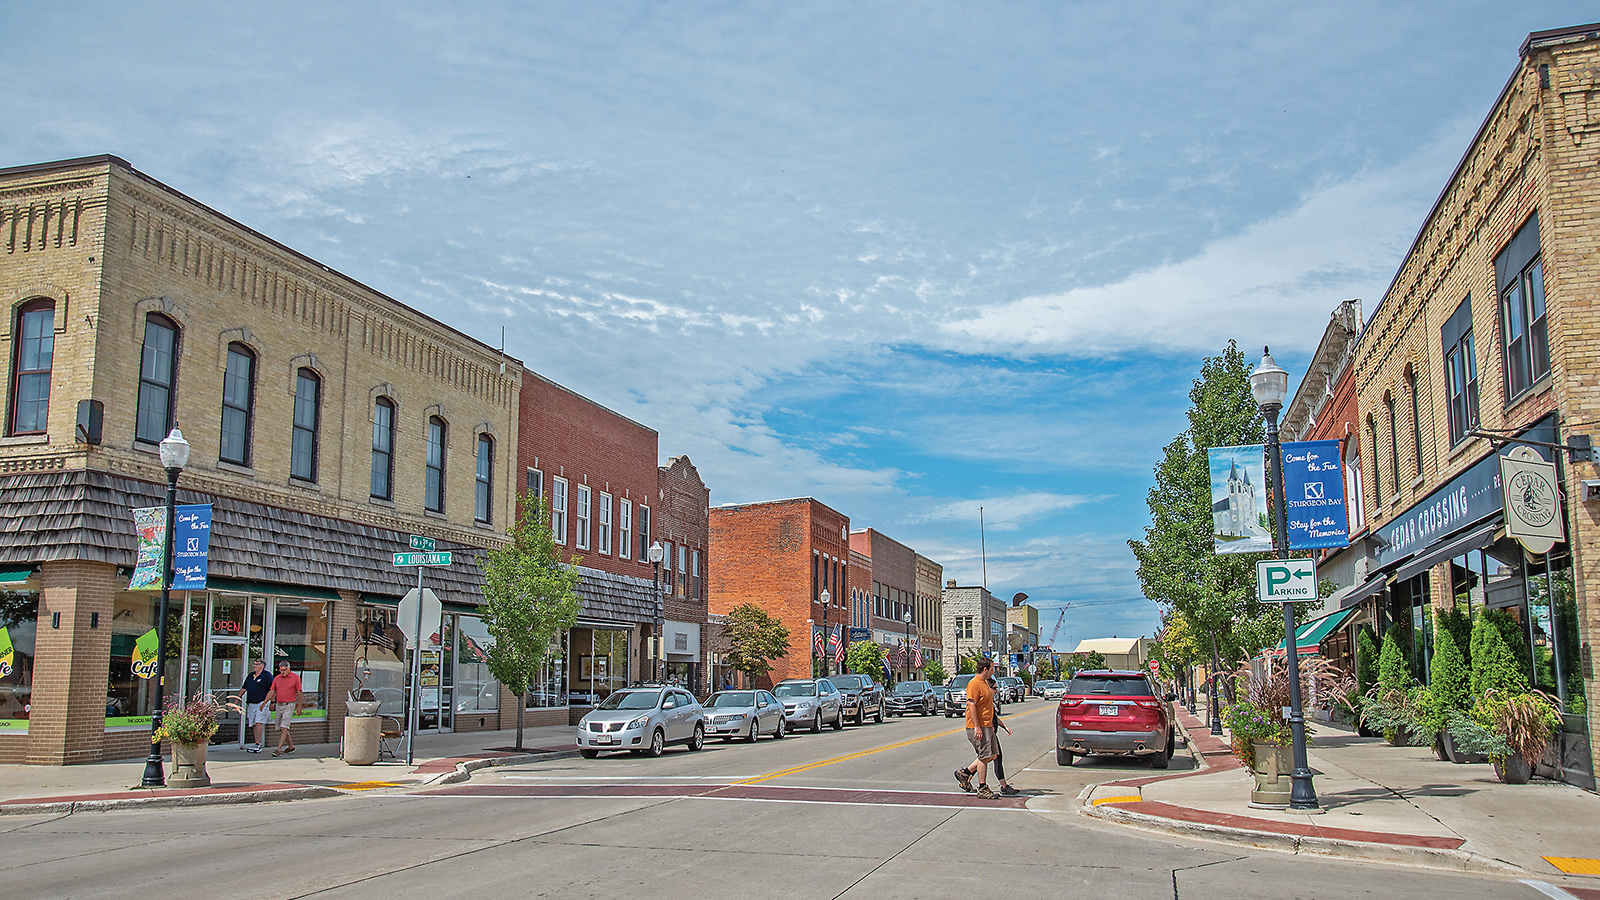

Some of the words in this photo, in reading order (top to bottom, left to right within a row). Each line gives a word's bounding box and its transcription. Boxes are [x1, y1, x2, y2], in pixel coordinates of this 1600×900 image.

[1285, 453, 1306, 463] Come
[1307, 451, 1319, 462] for
[1307, 462, 1321, 472] the
[1322, 461, 1338, 472] Fun
[1515, 474, 1546, 492] CEDAR
[1288, 499, 1326, 508] STURGEON
[1328, 498, 1342, 507] BAY
[178, 514, 190, 522] Come
[190, 513, 199, 522] for
[1391, 519, 1415, 552] CEDAR
[1418, 485, 1468, 537] CROSSING
[1517, 504, 1552, 523] CROSSING
[199, 521, 209, 529] Fun
[1289, 520, 1310, 532] Stay
[1310, 518, 1321, 529] for
[1322, 516, 1336, 526] the
[1309, 528, 1346, 538] Memories
[408, 554, 440, 564] LOUISIANA
[176, 566, 187, 576] Stay
[194, 565, 202, 573] the
[213, 620, 240, 632] OPEN
[140, 648, 150, 657] THE
[142, 649, 158, 664] CORNE
